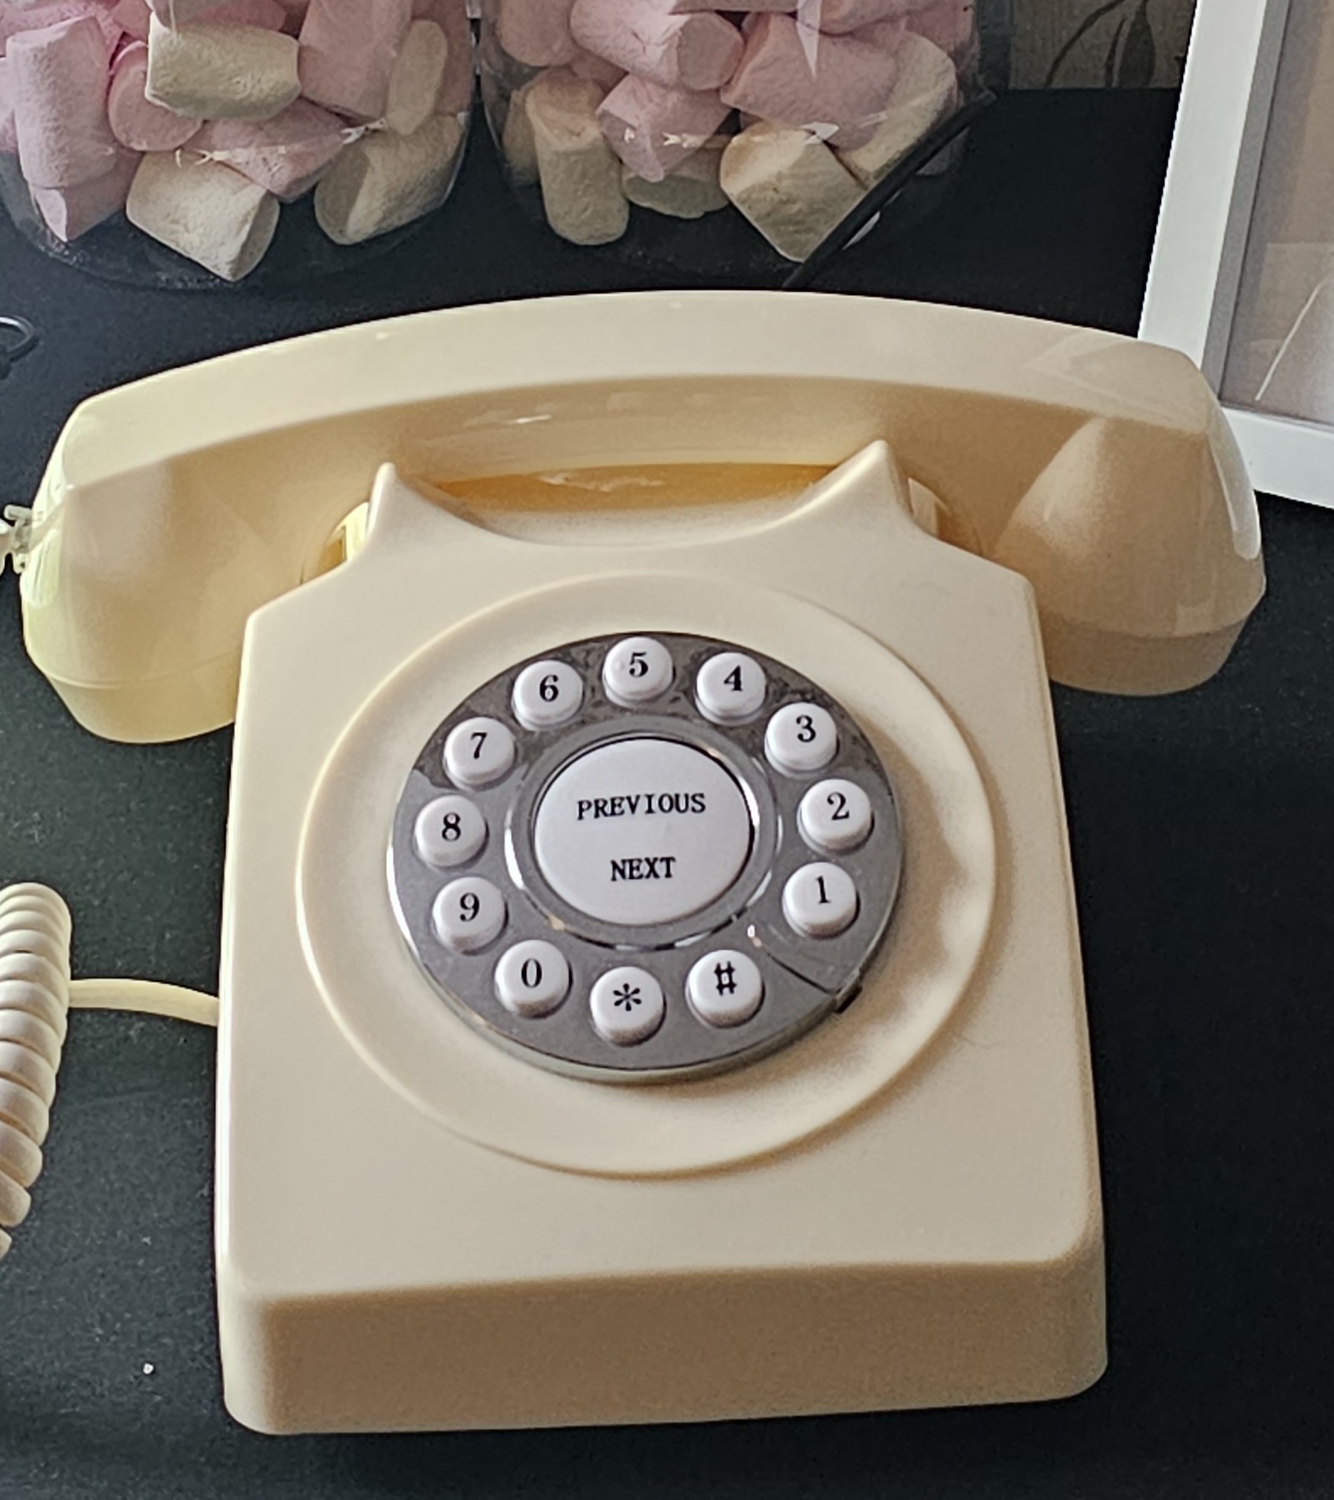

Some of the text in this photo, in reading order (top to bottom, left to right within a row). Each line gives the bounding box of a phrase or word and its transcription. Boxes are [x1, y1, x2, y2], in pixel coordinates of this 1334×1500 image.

[628, 651, 649, 678] 5
[723, 665, 744, 693] 4
[538, 674, 560, 702] 6
[795, 714, 817, 743] 3
[469, 732, 488, 760] 7
[576, 793, 707, 821] PREVIOUS
[826, 792, 851, 821] 2
[440, 812, 462, 842] 8
[609, 856, 677, 882] NEXT
[815, 875, 830, 905] 1
[458, 893, 481, 922] 9
[521, 959, 543, 989] 0
[714, 961, 738, 996] #
